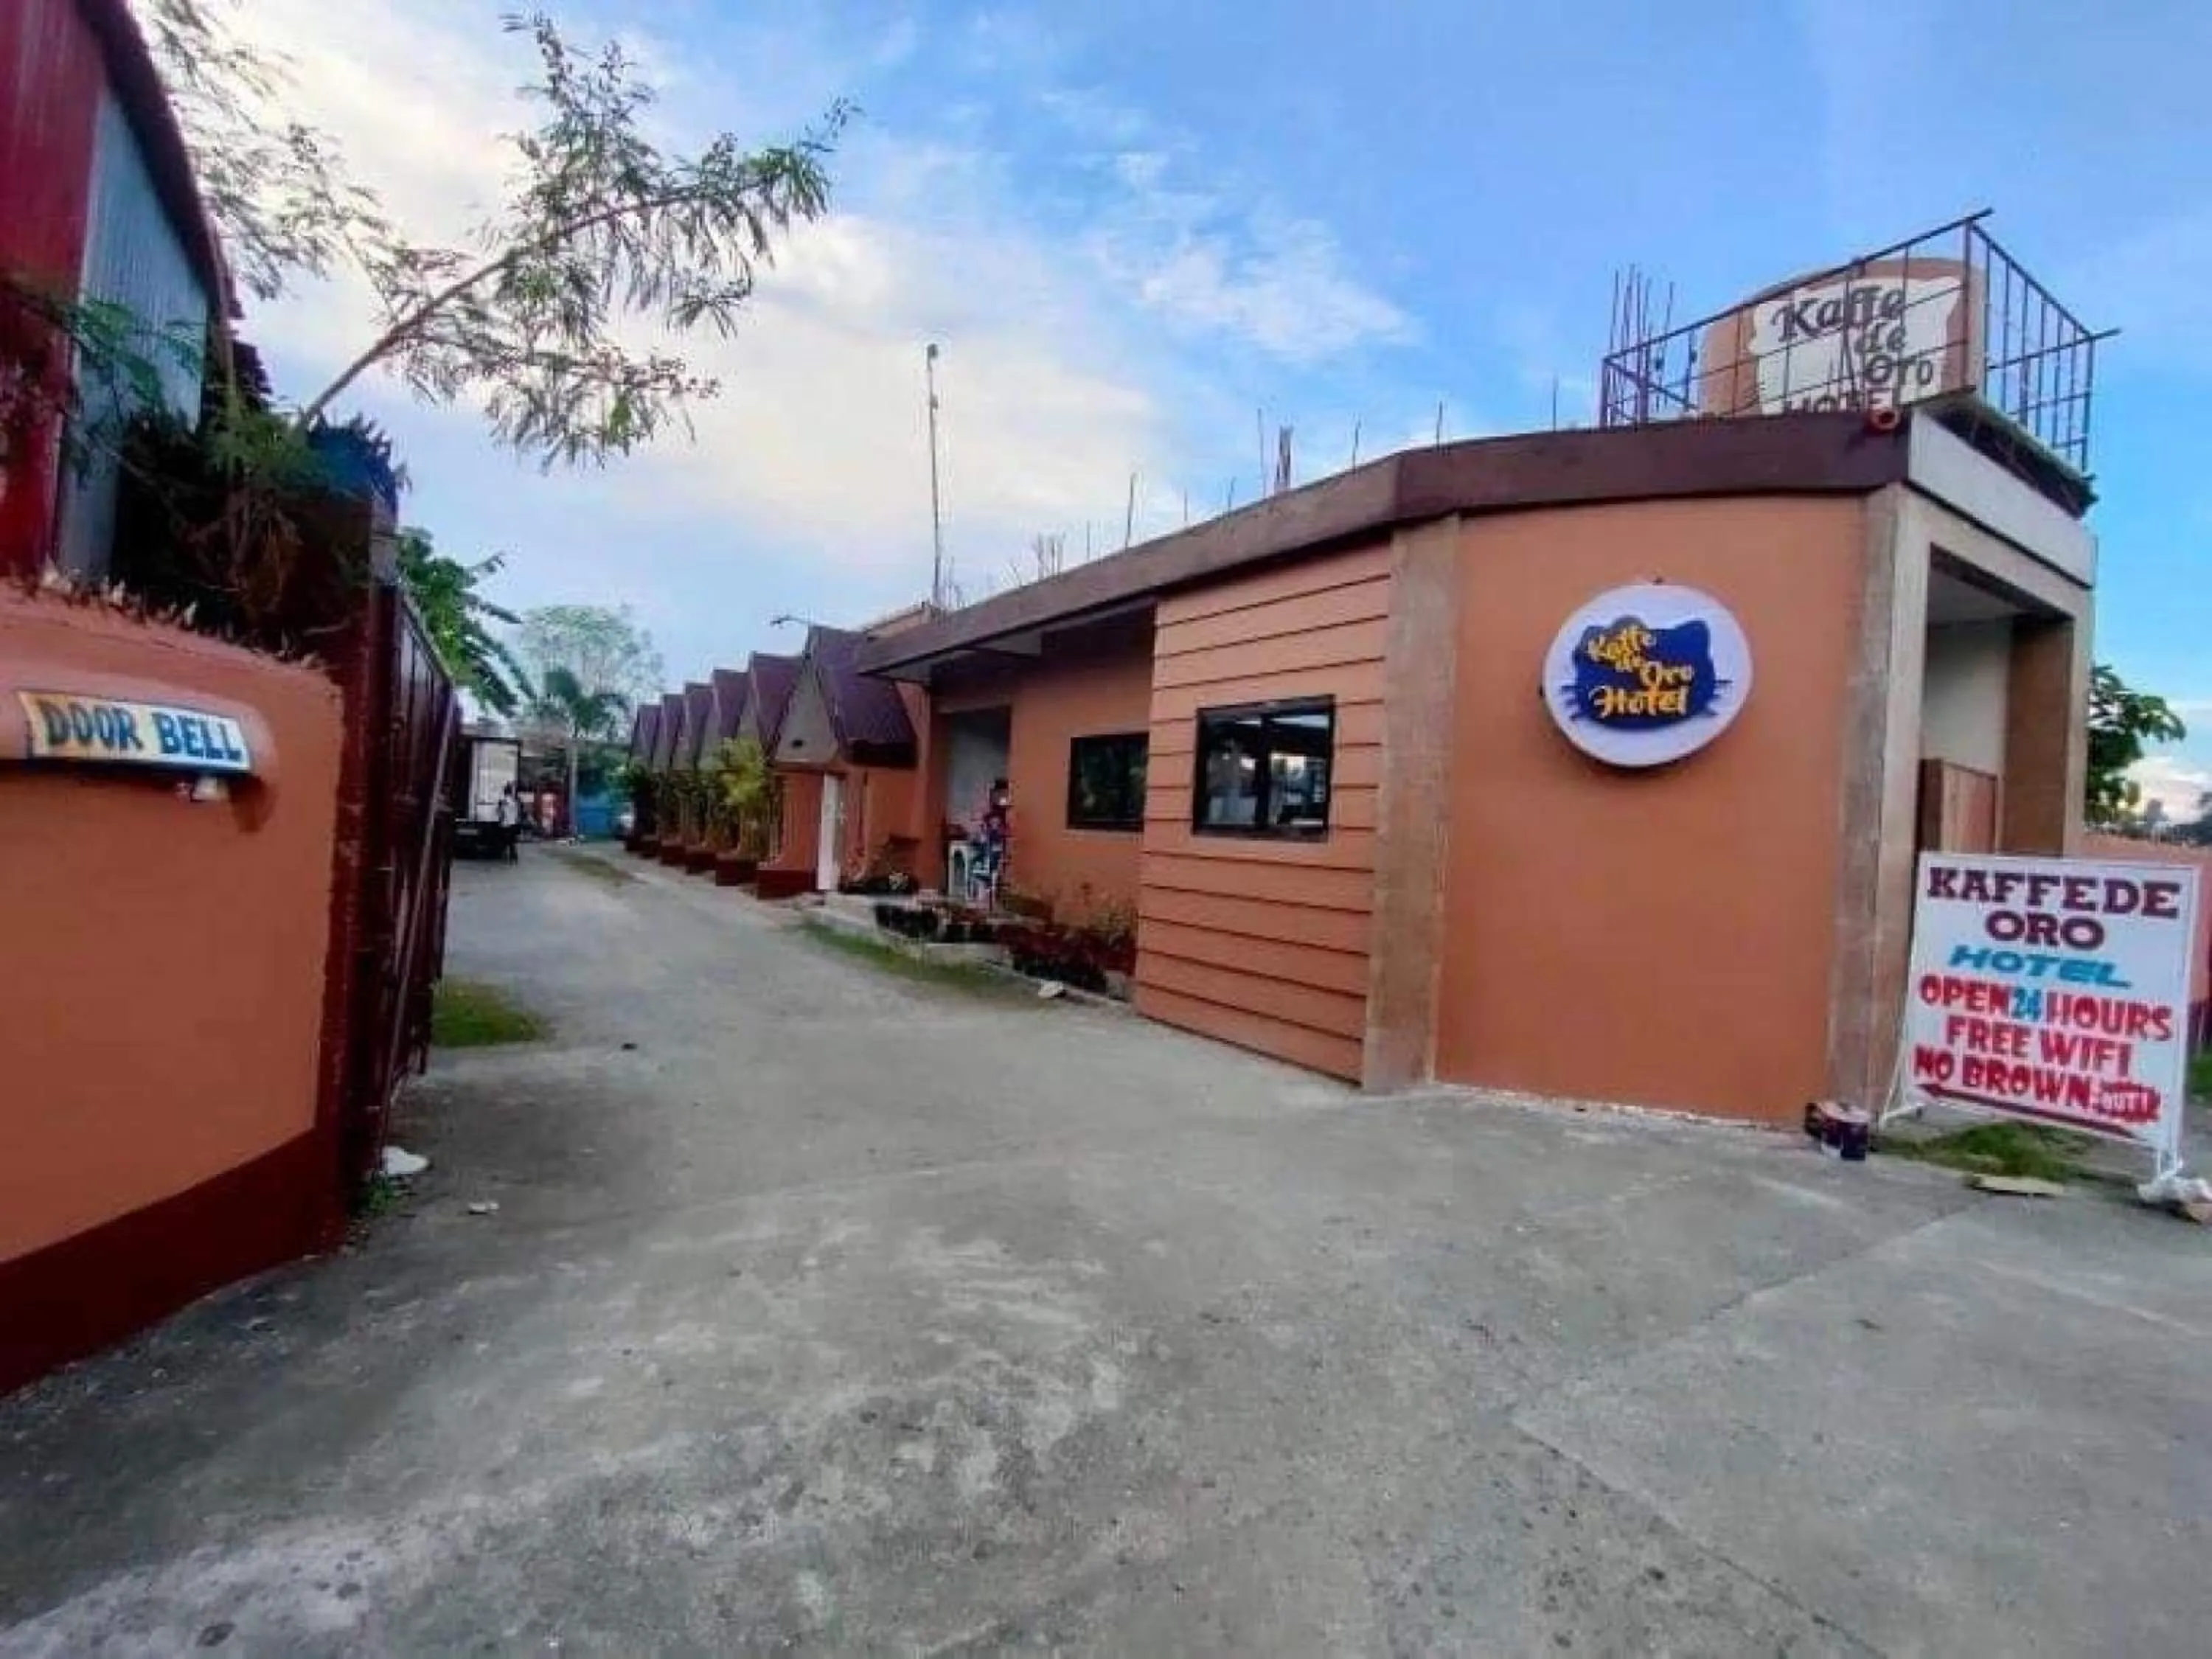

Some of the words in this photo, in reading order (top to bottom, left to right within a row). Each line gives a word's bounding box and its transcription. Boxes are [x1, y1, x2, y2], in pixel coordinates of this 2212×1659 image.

[39, 698, 144, 751] DOOR
[150, 712, 243, 761] BELL
[1588, 686, 1689, 718] Hotel
[1985, 911, 2105, 950] ORO
[1947, 945, 2132, 989] HOTEL
[1920, 975, 2009, 1018] OPEN
[2046, 992, 2173, 1040] HOURS
[1947, 1015, 2031, 1057] FREE
[2040, 1029, 2131, 1076] WIFI
[1913, 1044, 1954, 1081] NO
[1962, 1054, 2091, 1110] BROWN
